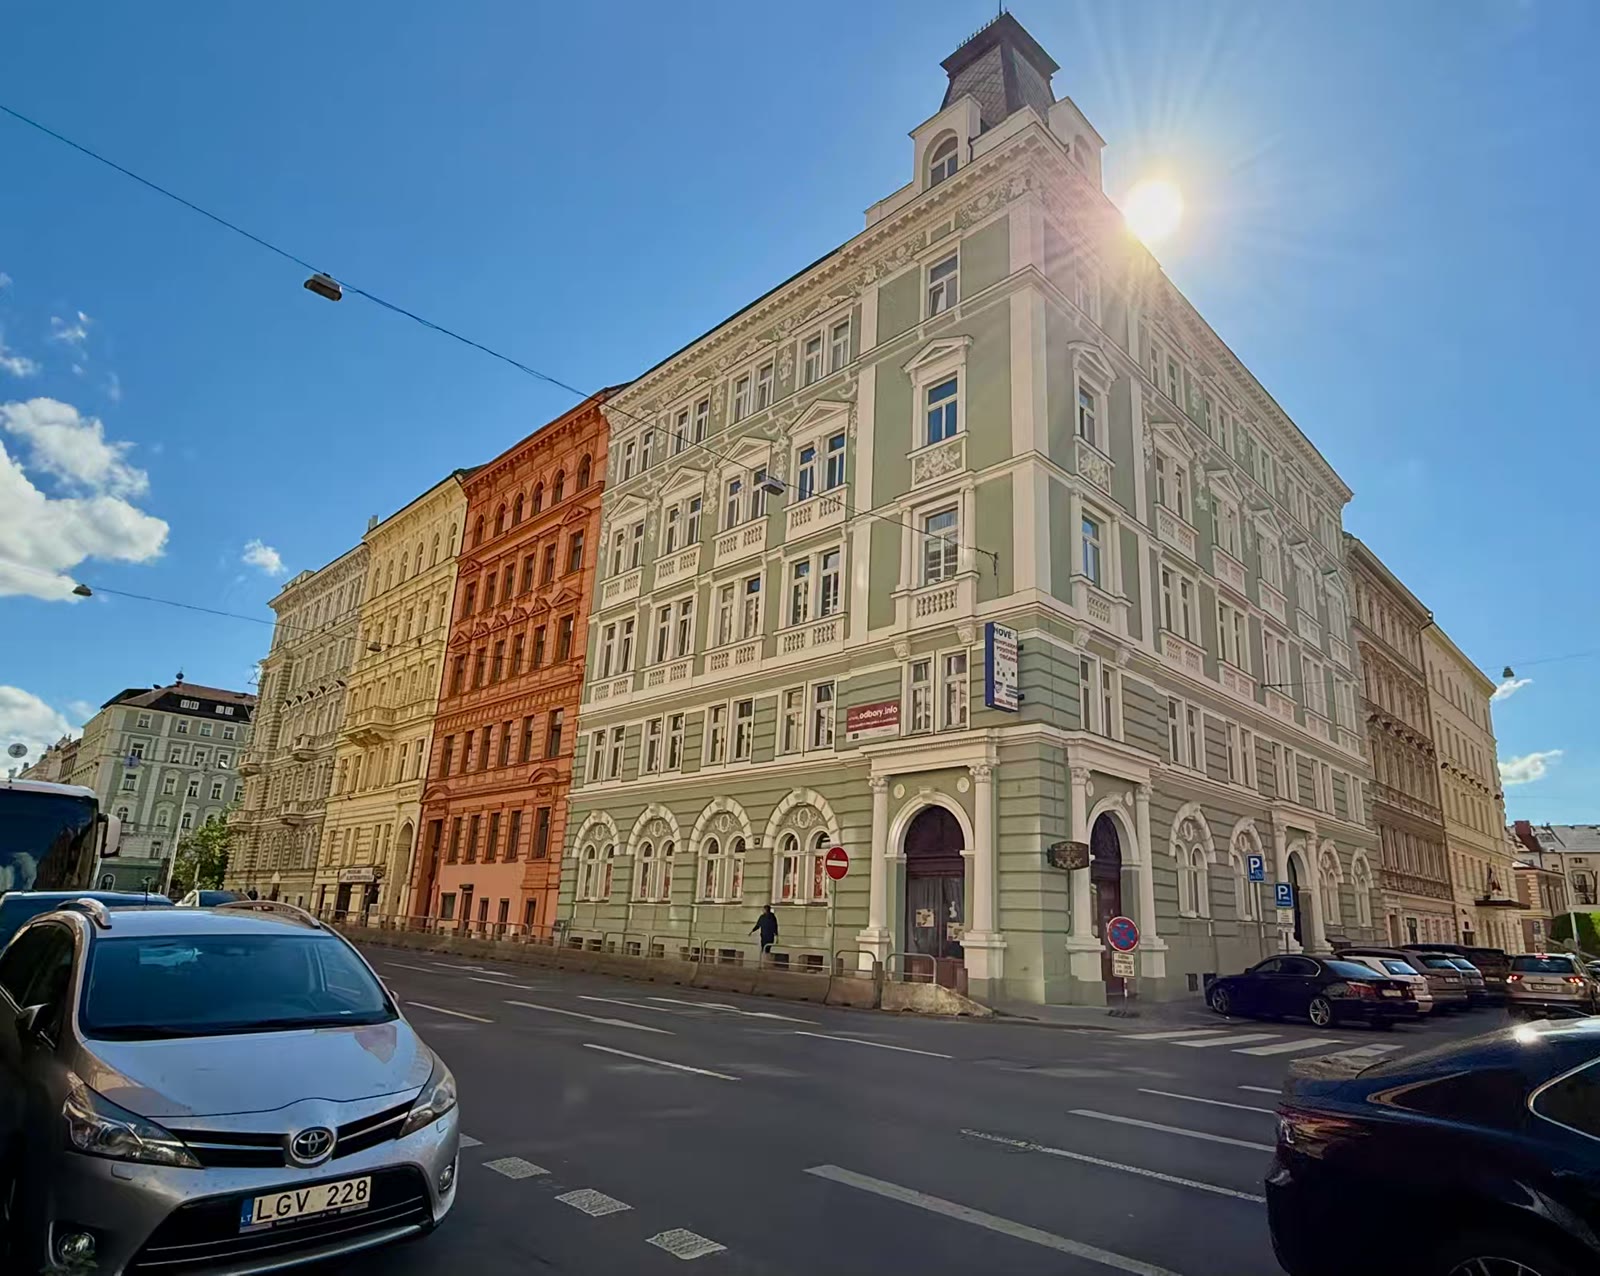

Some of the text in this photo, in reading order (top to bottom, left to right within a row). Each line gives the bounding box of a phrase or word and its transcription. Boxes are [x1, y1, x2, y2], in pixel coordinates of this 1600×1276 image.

[1250, 858, 1260, 873] P
[1277, 885, 1288, 900] P
[240, 1214, 252, 1223] LT
[256, 1190, 311, 1221] LGV
[326, 1179, 368, 1207] 228
